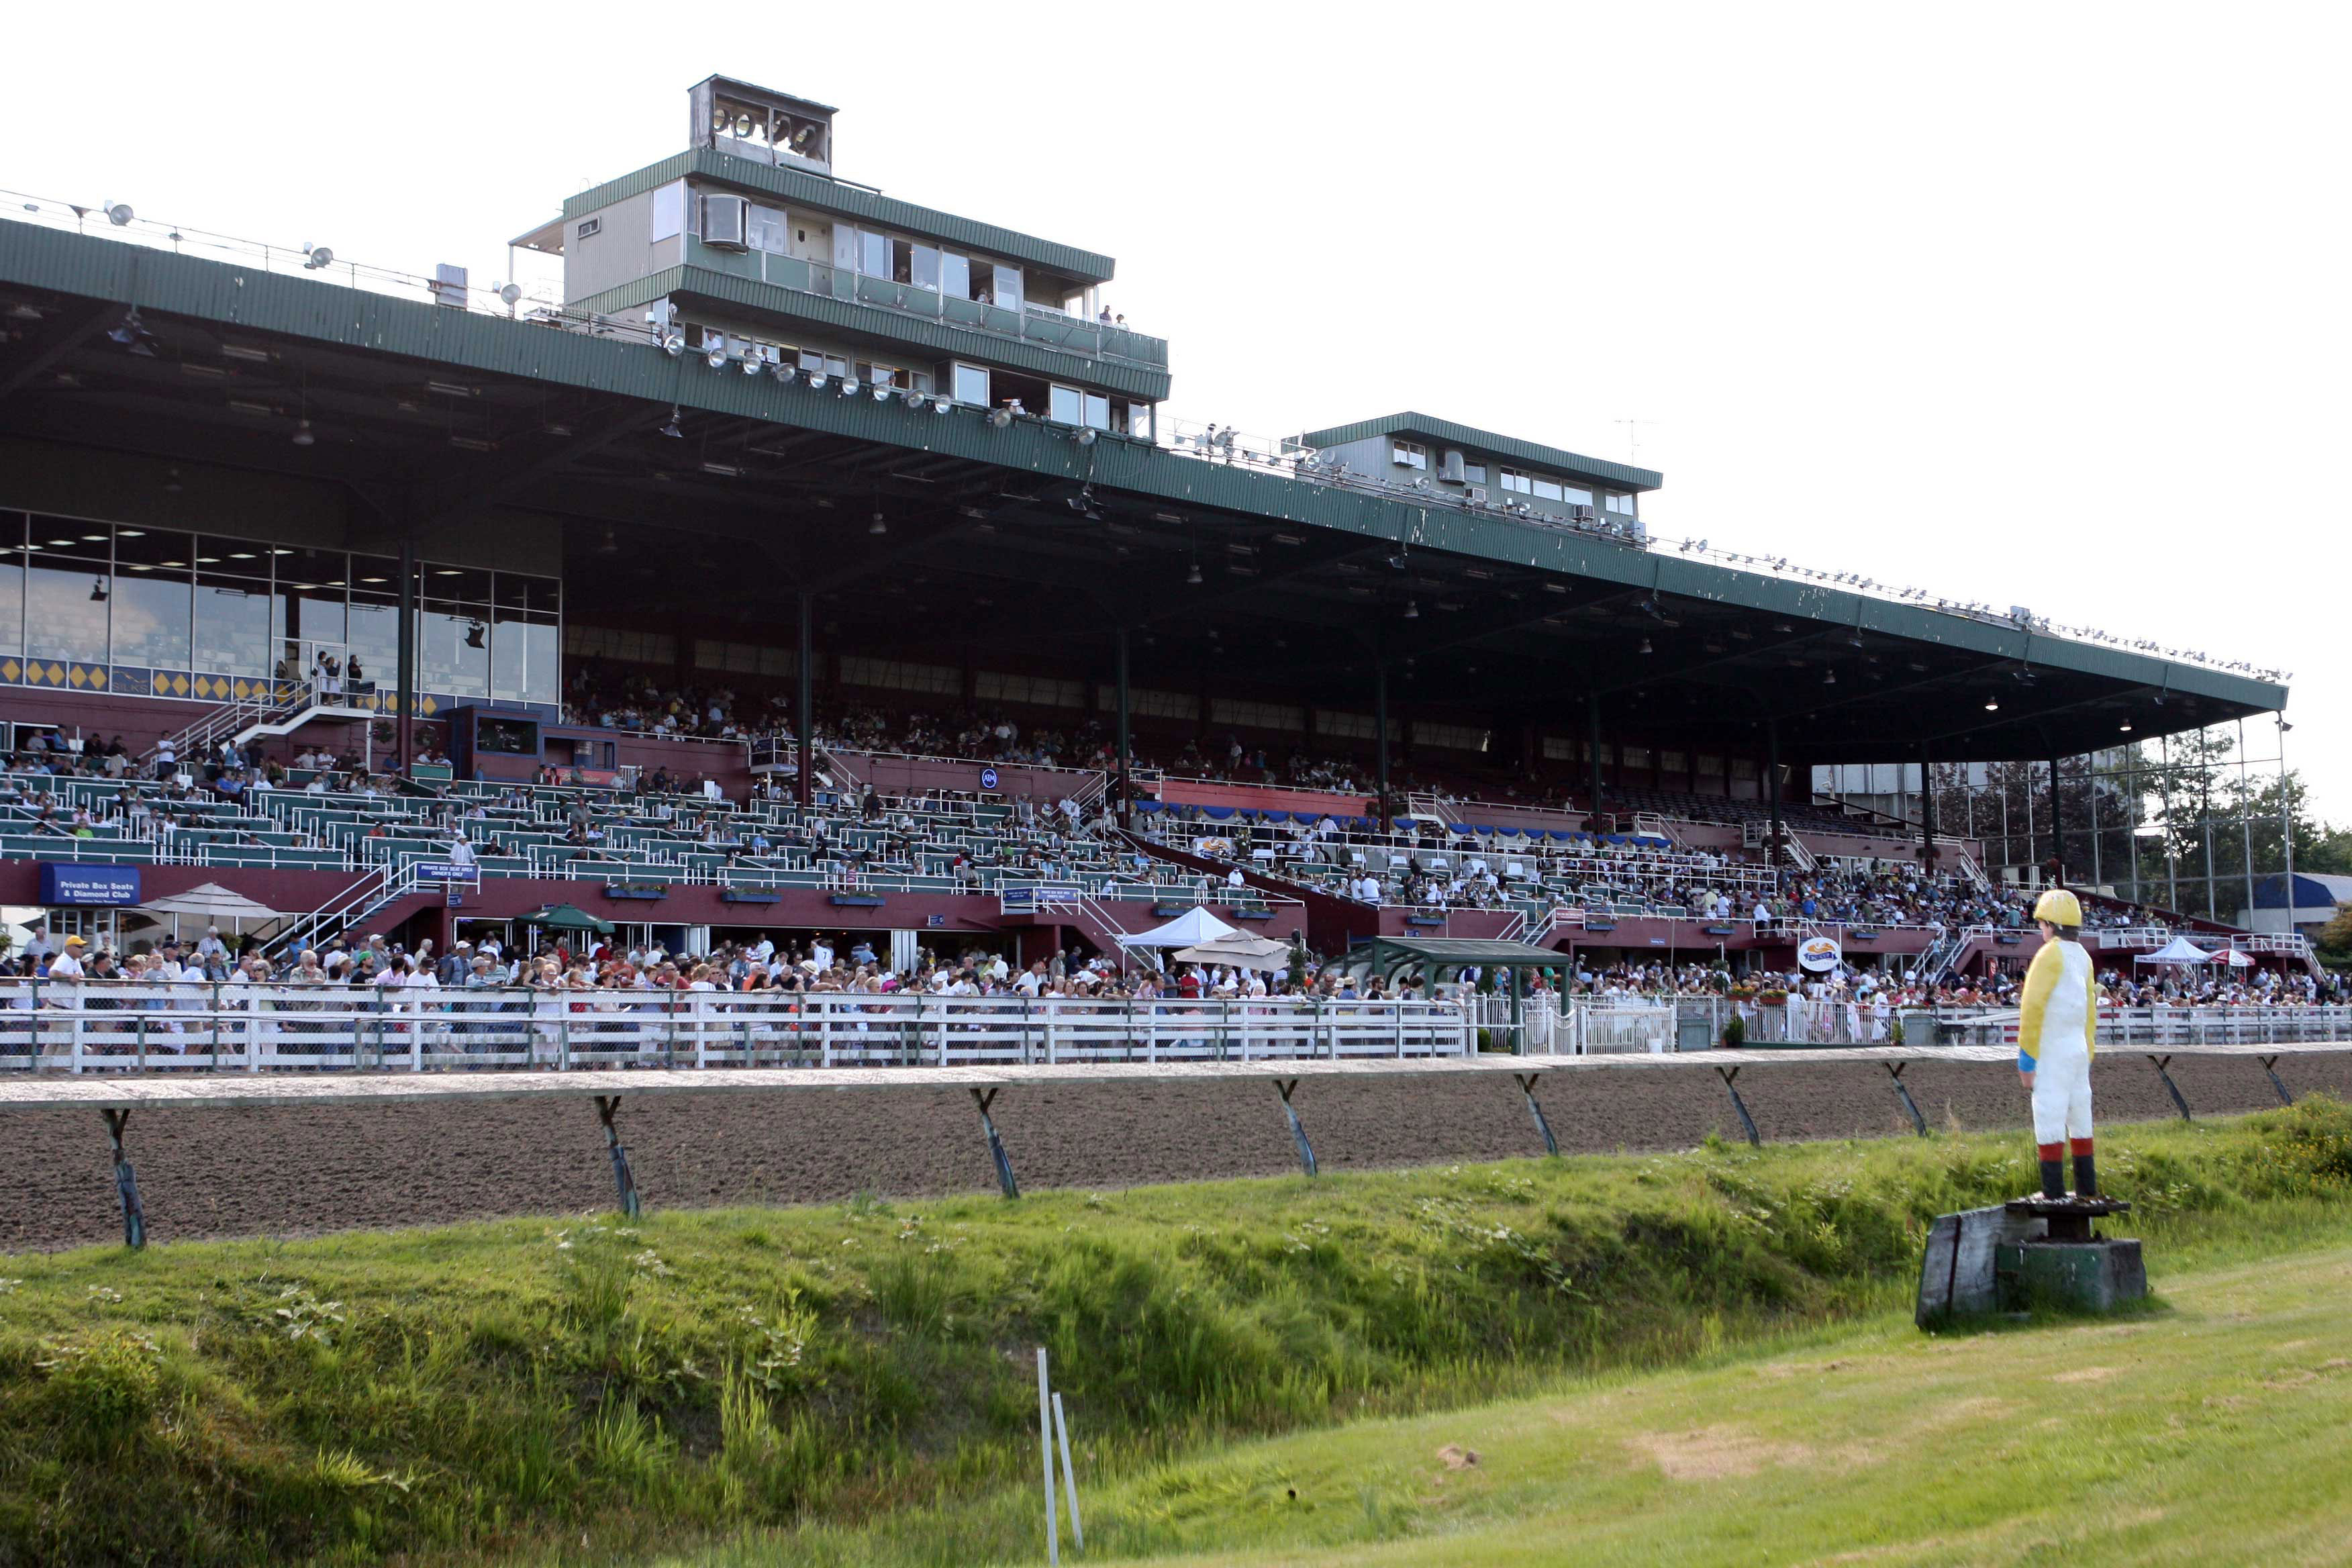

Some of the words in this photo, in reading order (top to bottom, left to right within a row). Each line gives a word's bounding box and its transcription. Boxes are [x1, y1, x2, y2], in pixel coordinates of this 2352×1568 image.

[112, 681, 149, 693] SILKS
[984, 773, 996, 782] ATM
[822, 951, 827, 959] 7
